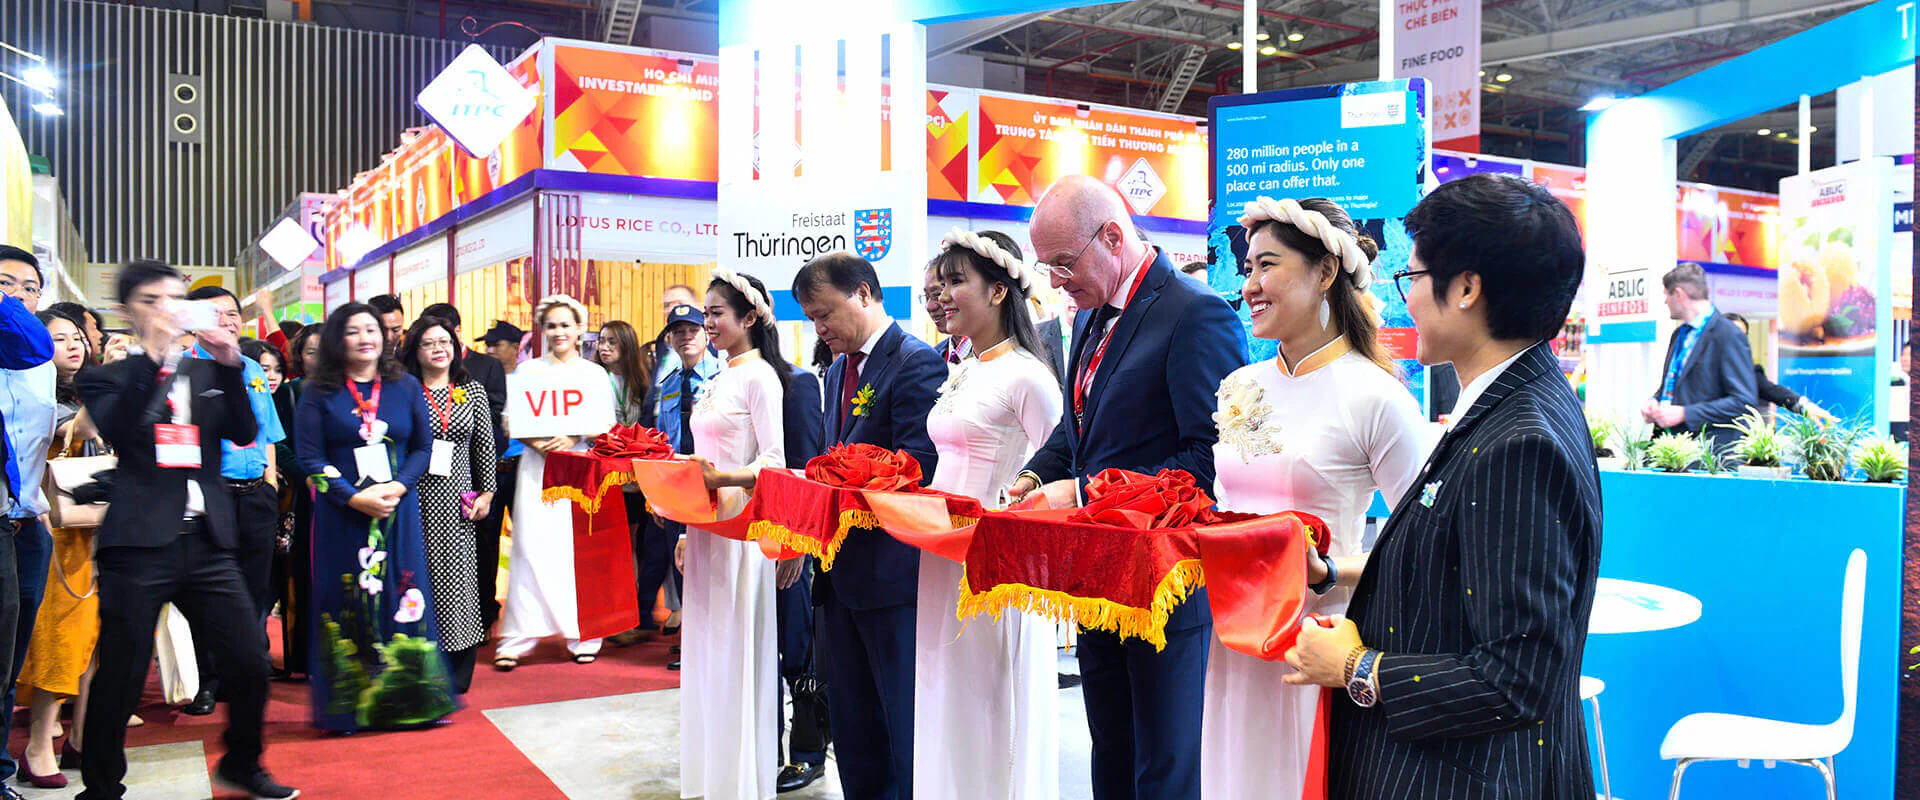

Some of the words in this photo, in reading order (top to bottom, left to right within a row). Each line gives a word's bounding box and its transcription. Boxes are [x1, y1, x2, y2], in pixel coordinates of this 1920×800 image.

[1402, 54, 1427, 70] FINE
[1430, 46, 1464, 63] FOOD
[644, 68, 665, 80] HO
[578, 76, 678, 98] INVESTMEN
[452, 104, 504, 117] ITPC
[995, 124, 1037, 139] TRUNG
[1227, 148, 1249, 160] 280
[1251, 144, 1290, 159] million
[1293, 141, 1334, 158] people
[1337, 140, 1348, 153] in
[1351, 141, 1359, 152] a
[1227, 164, 1249, 176] 500
[1251, 161, 1266, 174] mi
[1269, 160, 1309, 174] radius.
[1312, 157, 1339, 172] Only
[1342, 157, 1365, 168] one
[1130, 188, 1153, 197] ITPC
[1226, 180, 1256, 195] place
[1259, 178, 1279, 190] can
[1282, 175, 1310, 188] offer
[1312, 174, 1341, 187] that.
[556, 215, 610, 230] LOTUS
[616, 218, 653, 232] RICE
[659, 220, 691, 236] CO.,
[792, 212, 846, 228] Freistaat
[733, 231, 846, 262] Thüringen
[1608, 278, 1645, 299] ABLIG
[525, 389, 584, 417] VIP
